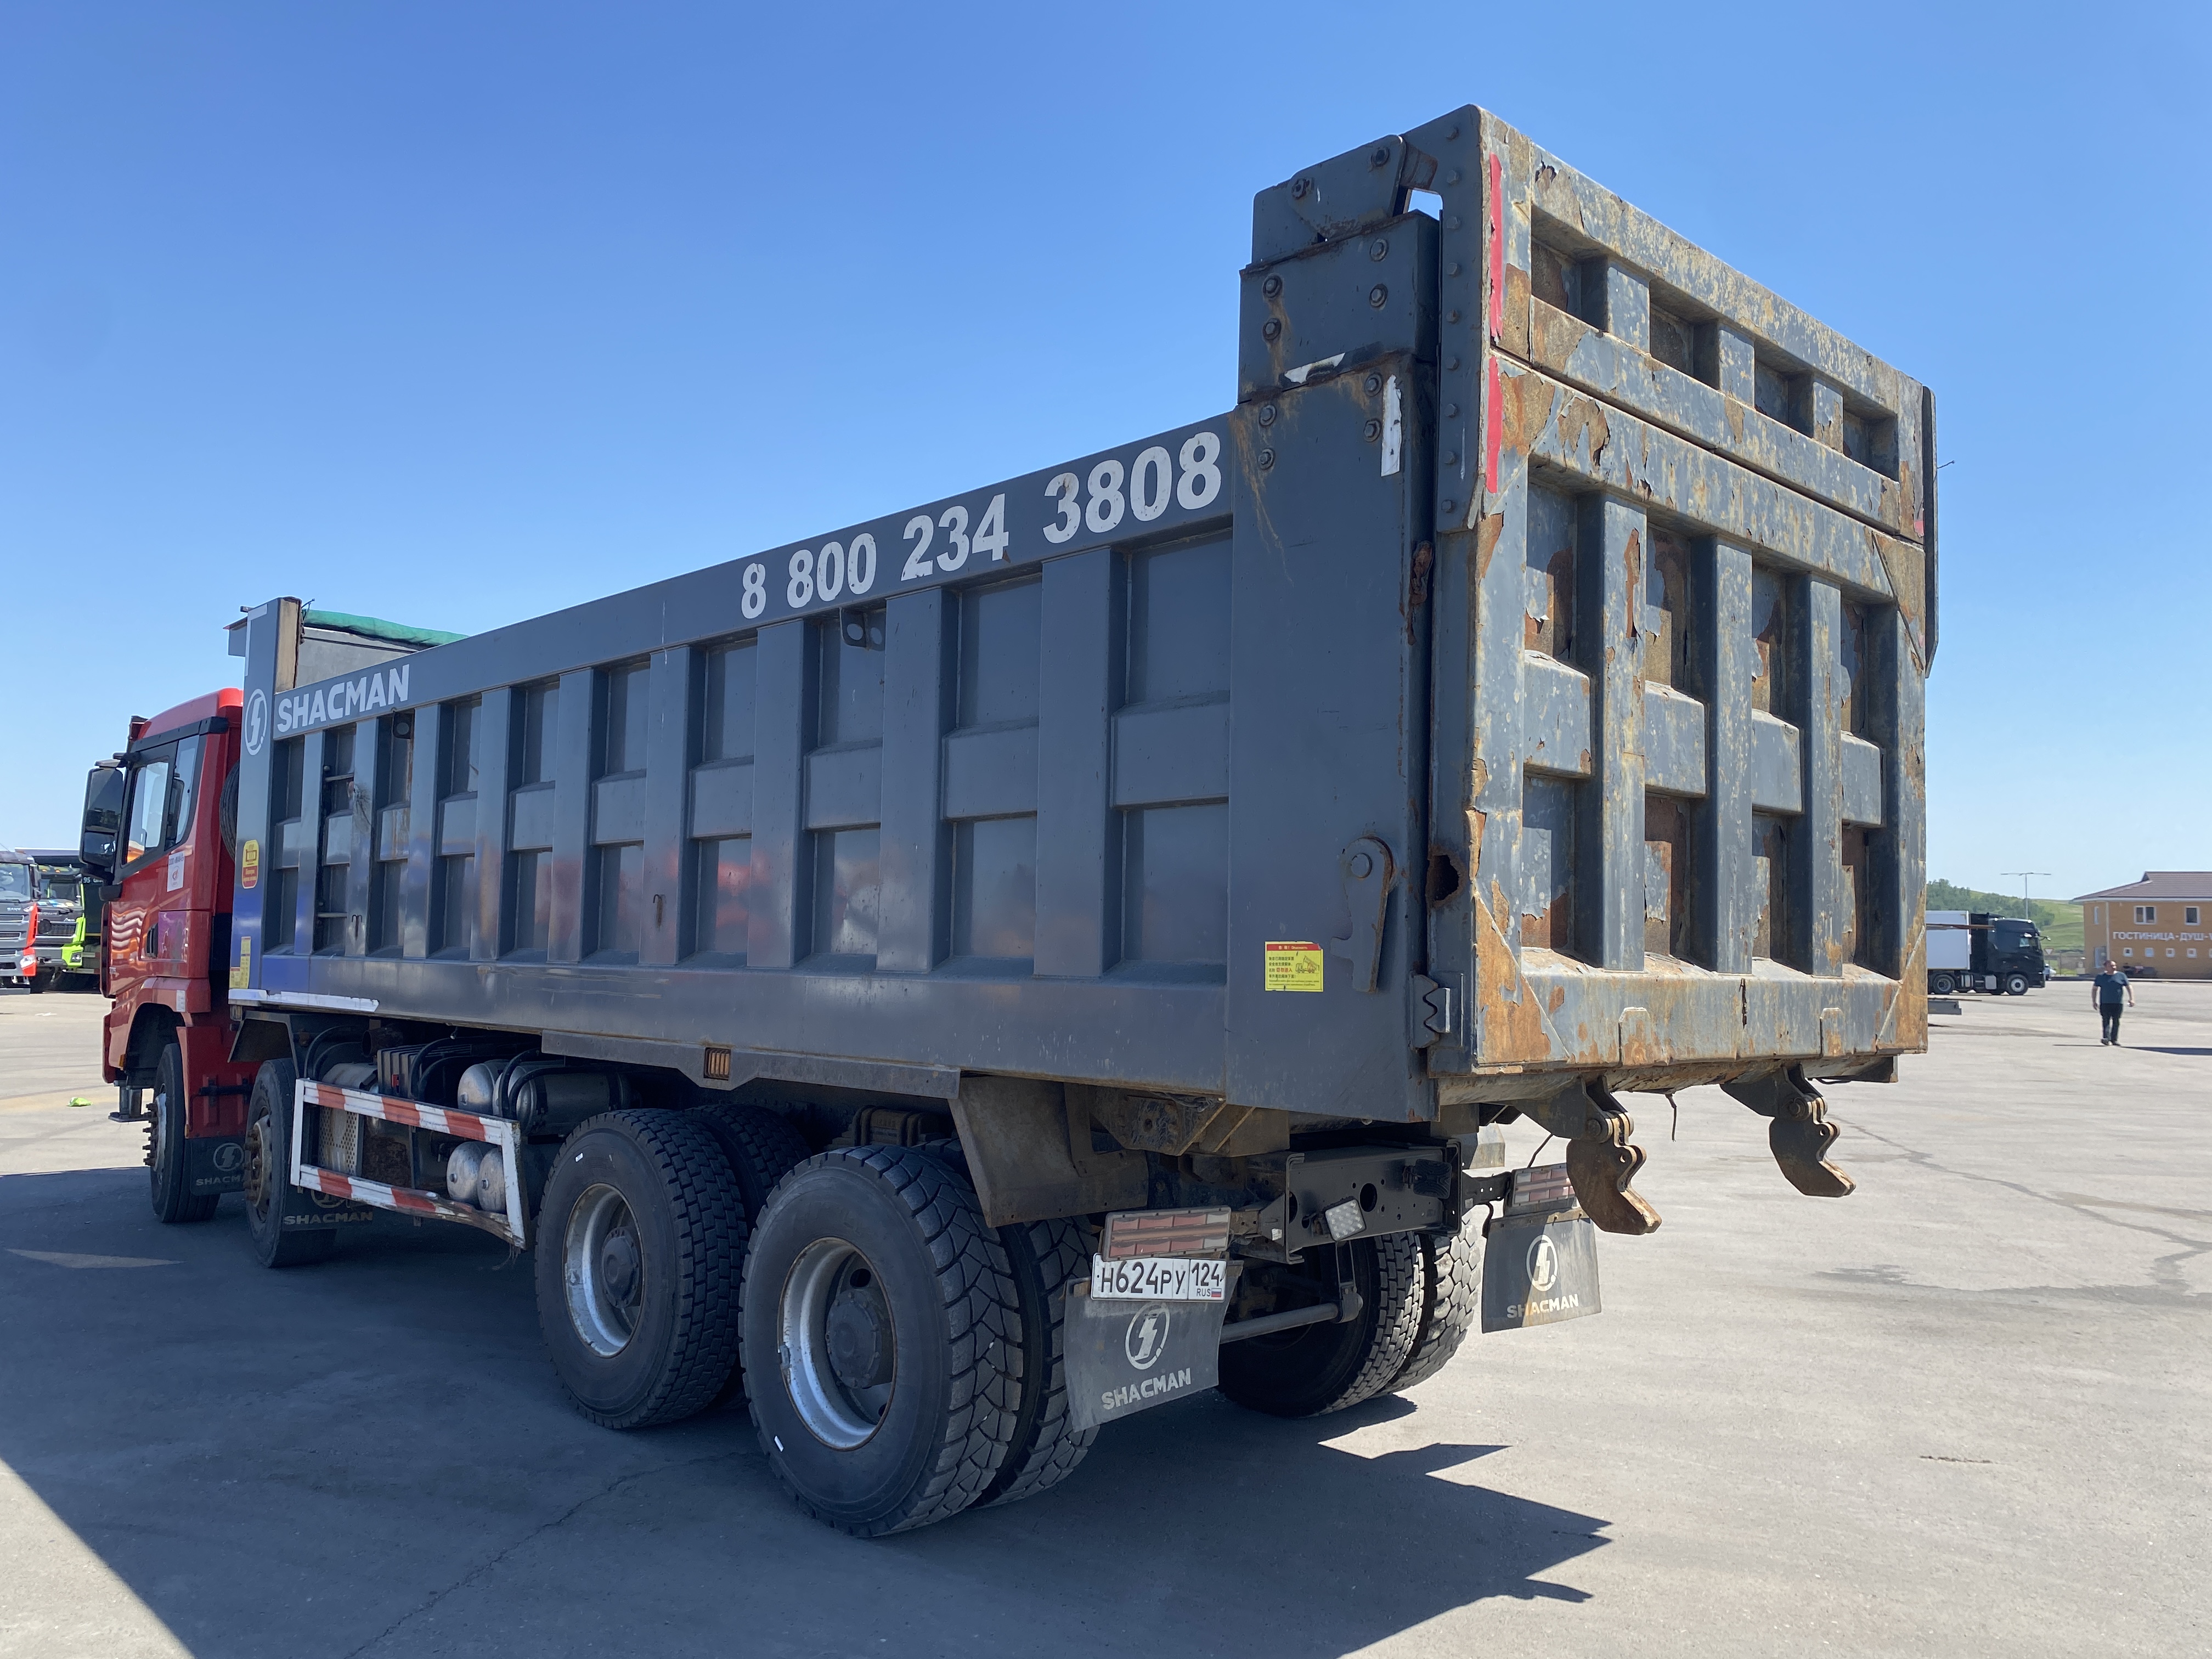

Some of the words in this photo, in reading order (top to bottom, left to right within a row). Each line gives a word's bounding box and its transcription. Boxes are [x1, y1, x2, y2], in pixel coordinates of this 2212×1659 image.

[741, 562, 766, 619] 8
[786, 533, 877, 609] 800
[900, 493, 1009, 582] 234
[1042, 432, 1222, 544] 3808
[277, 664, 410, 733] SHACMAN
[196, 1174, 242, 1187] SHACM
[284, 1211, 374, 1226] SHACMAN
[1191, 1262, 1220, 1287] 124
[1196, 1288, 1211, 1297] RUS
[1506, 1293, 1579, 1319] SHACMAN
[1101, 1367, 1192, 1410] SHACMAN
